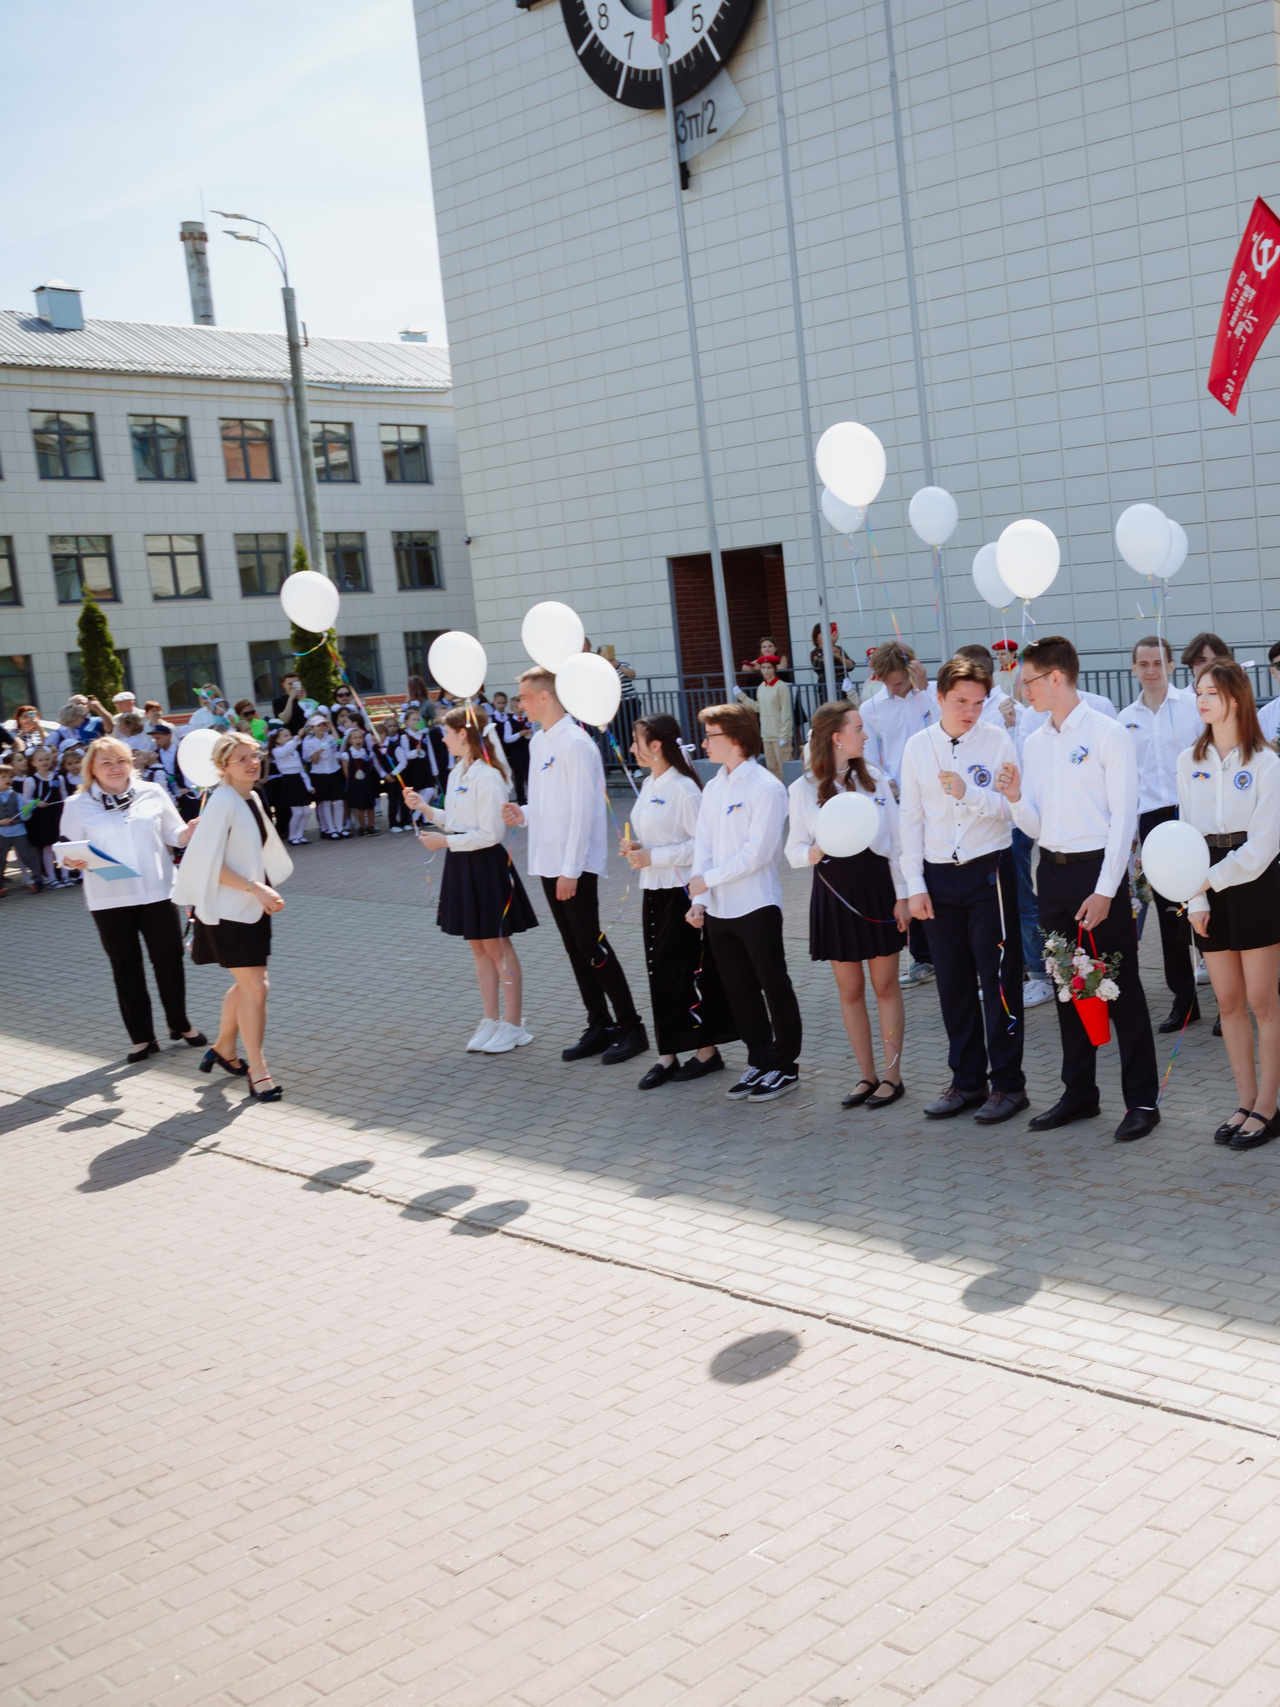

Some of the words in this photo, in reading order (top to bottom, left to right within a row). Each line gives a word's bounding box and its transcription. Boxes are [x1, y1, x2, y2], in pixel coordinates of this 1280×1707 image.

[598, 3, 609, 30] 8
[691, 4, 704, 33] 5
[623, 31, 635, 60] 7
